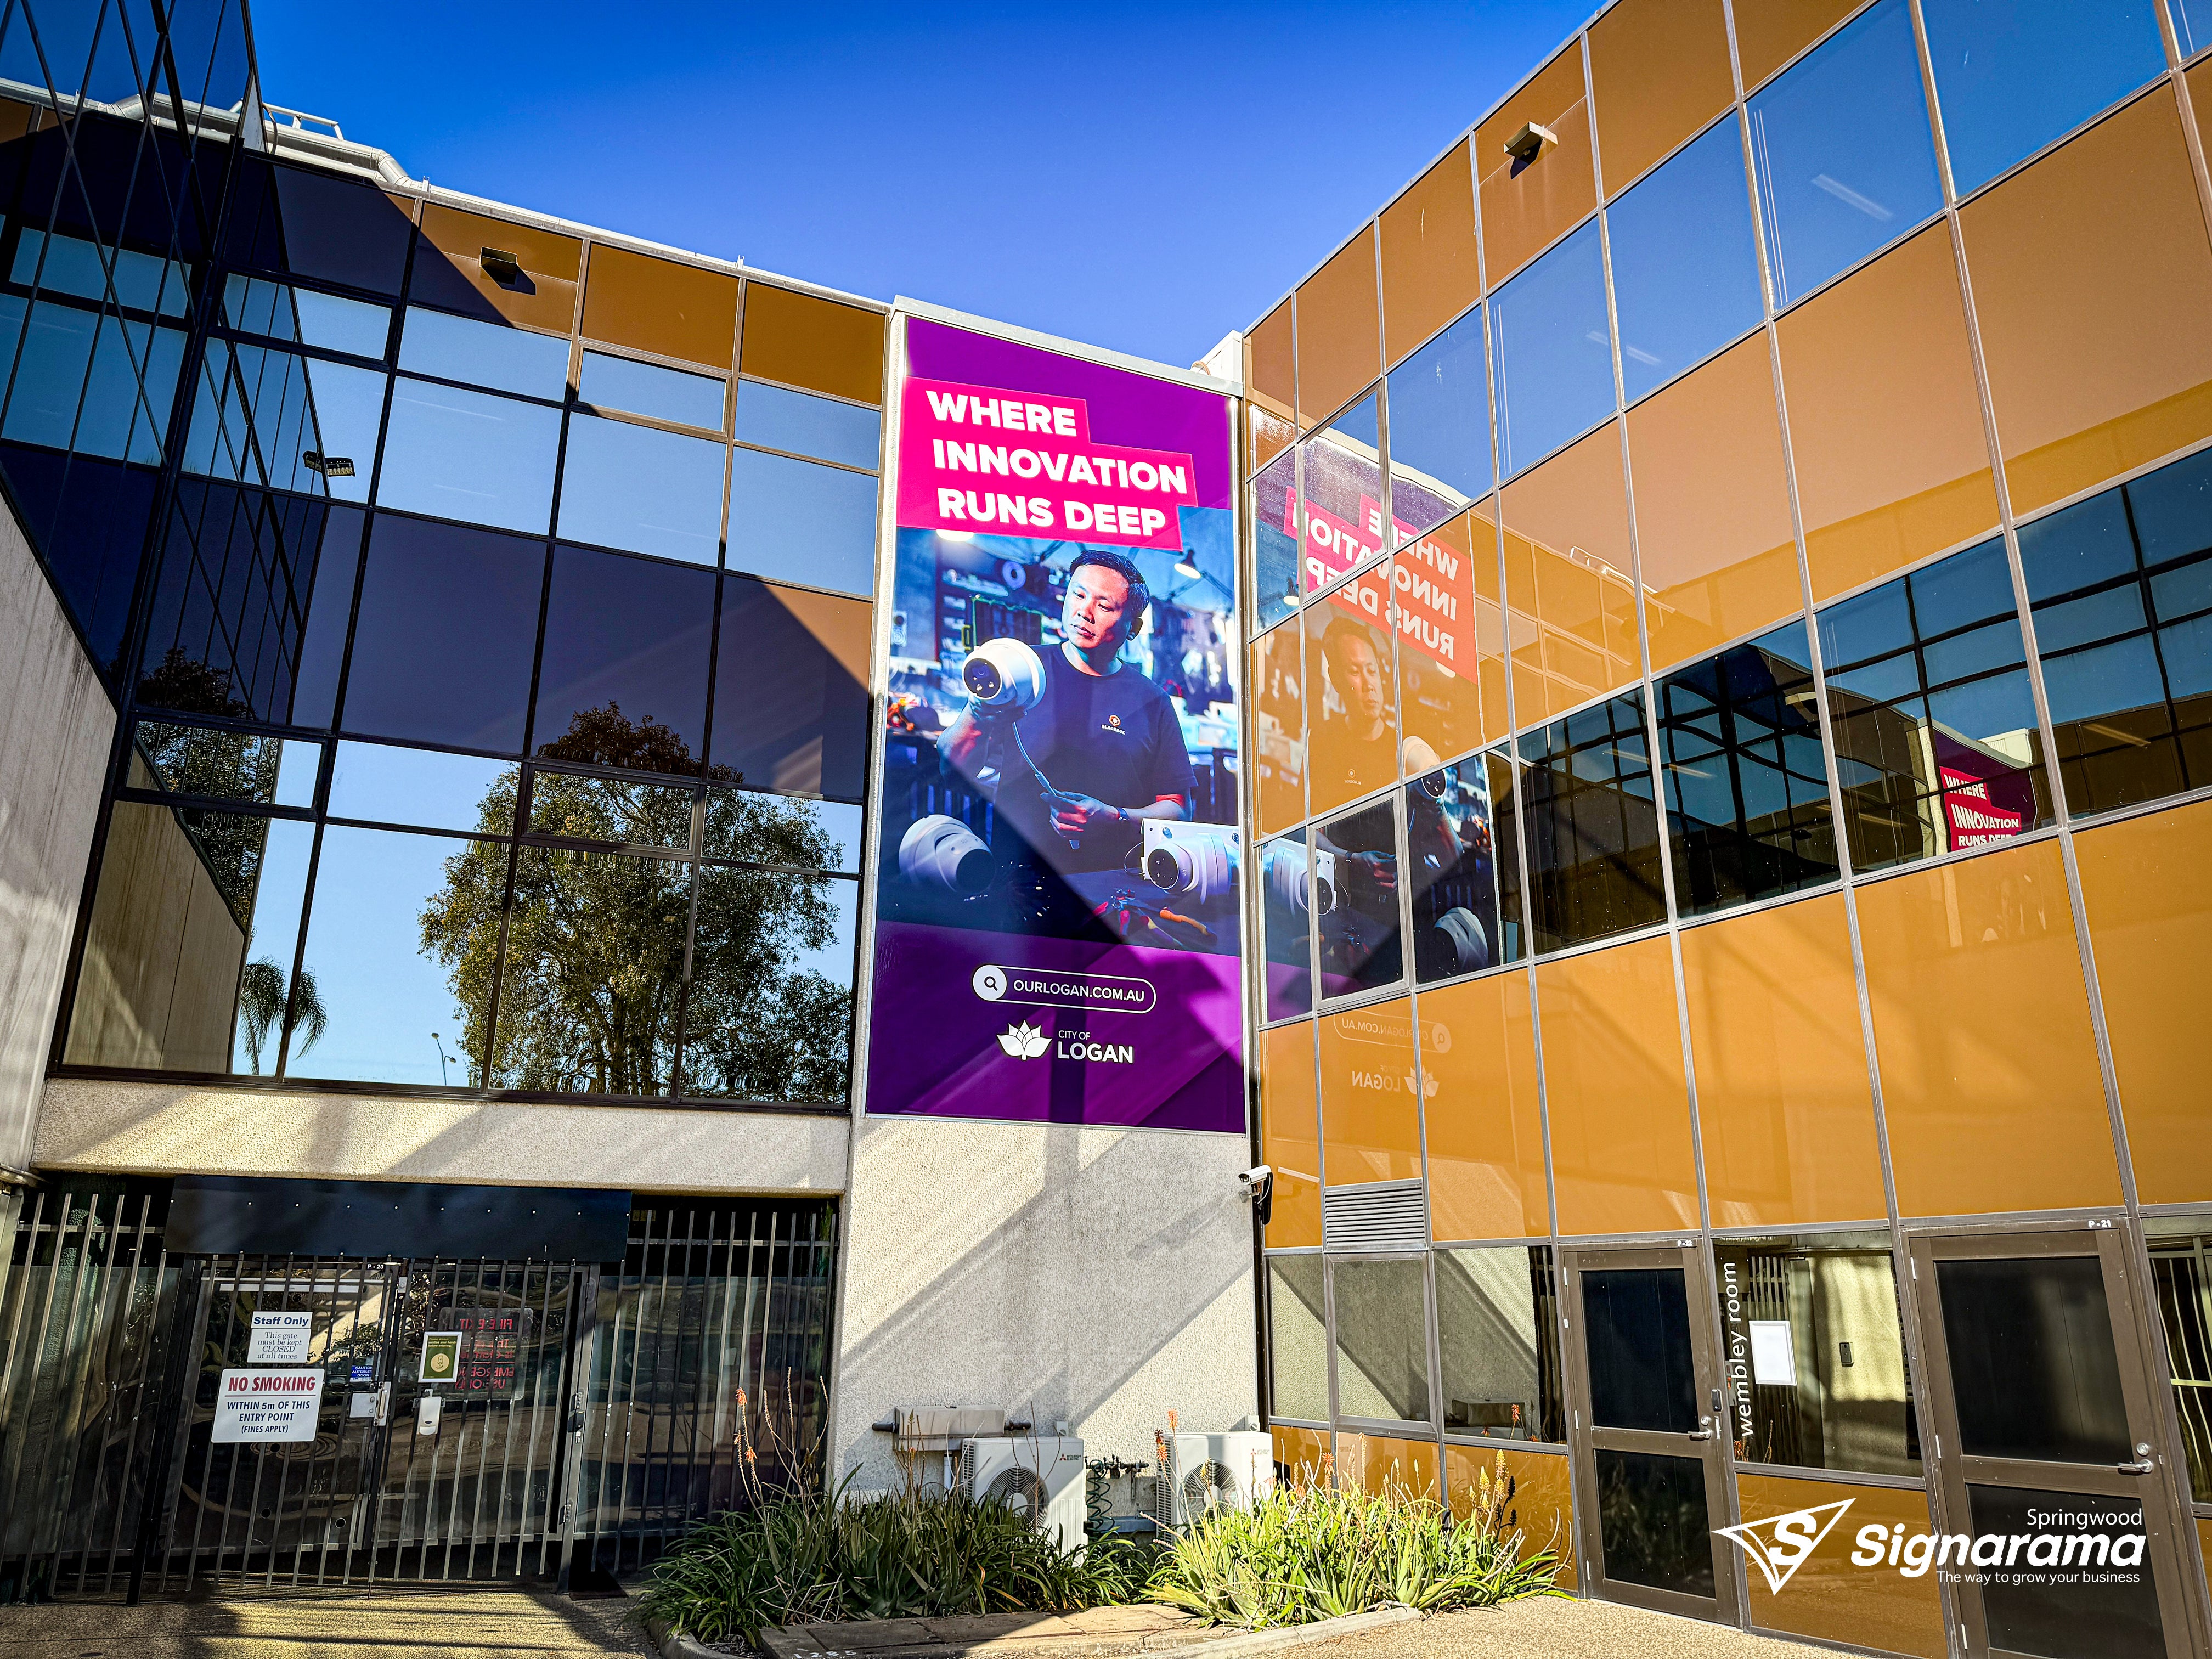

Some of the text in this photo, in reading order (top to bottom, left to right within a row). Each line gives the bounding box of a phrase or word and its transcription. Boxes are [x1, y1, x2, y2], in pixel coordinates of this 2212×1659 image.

[926, 390, 1077, 436] WHERE
[933, 439, 1187, 494] INNOVATION
[937, 488, 1165, 536] RUNS DEEP
[1101, 724, 1125, 735] BLACKBOX
[1944, 774, 1987, 800] WHERE
[1951, 803, 2019, 830] INNOVATION
[1958, 835, 1987, 847] RUNS
[1013, 980, 1144, 1002] OURLOGAN.COM.AU
[1058, 1030, 1091, 1040] CITY OF
[1058, 1041, 1133, 1064] LOGAN
[284, 1317, 309, 1327] Only
[1723, 1262, 1753, 1436] wembley room
[228, 1376, 315, 1391] NO SMOKING
[227, 1401, 259, 1409] WITHIN
[278, 1401, 289, 1409] OF
[292, 1401, 310, 1409] THIS
[239, 1413, 294, 1421] ENTRY POINT
[265, 1424, 289, 1433] APPLY)
